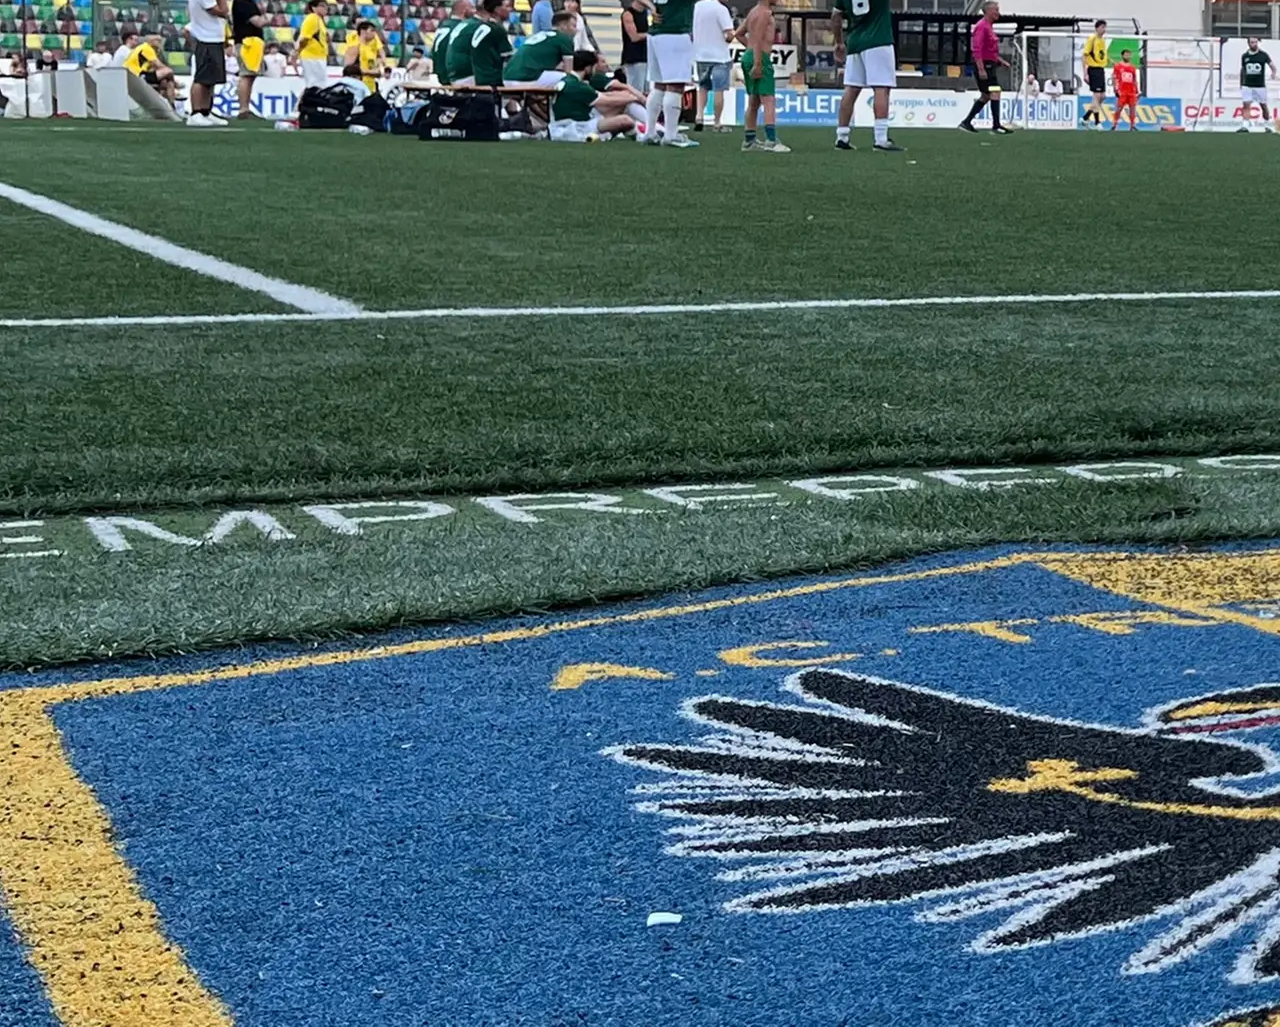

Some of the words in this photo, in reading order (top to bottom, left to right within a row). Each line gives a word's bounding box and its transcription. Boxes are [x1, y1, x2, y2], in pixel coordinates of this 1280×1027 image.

[889, 98, 923, 109] ruppo
[1185, 105, 1226, 119] CAF
[1233, 106, 1279, 120] ACI
